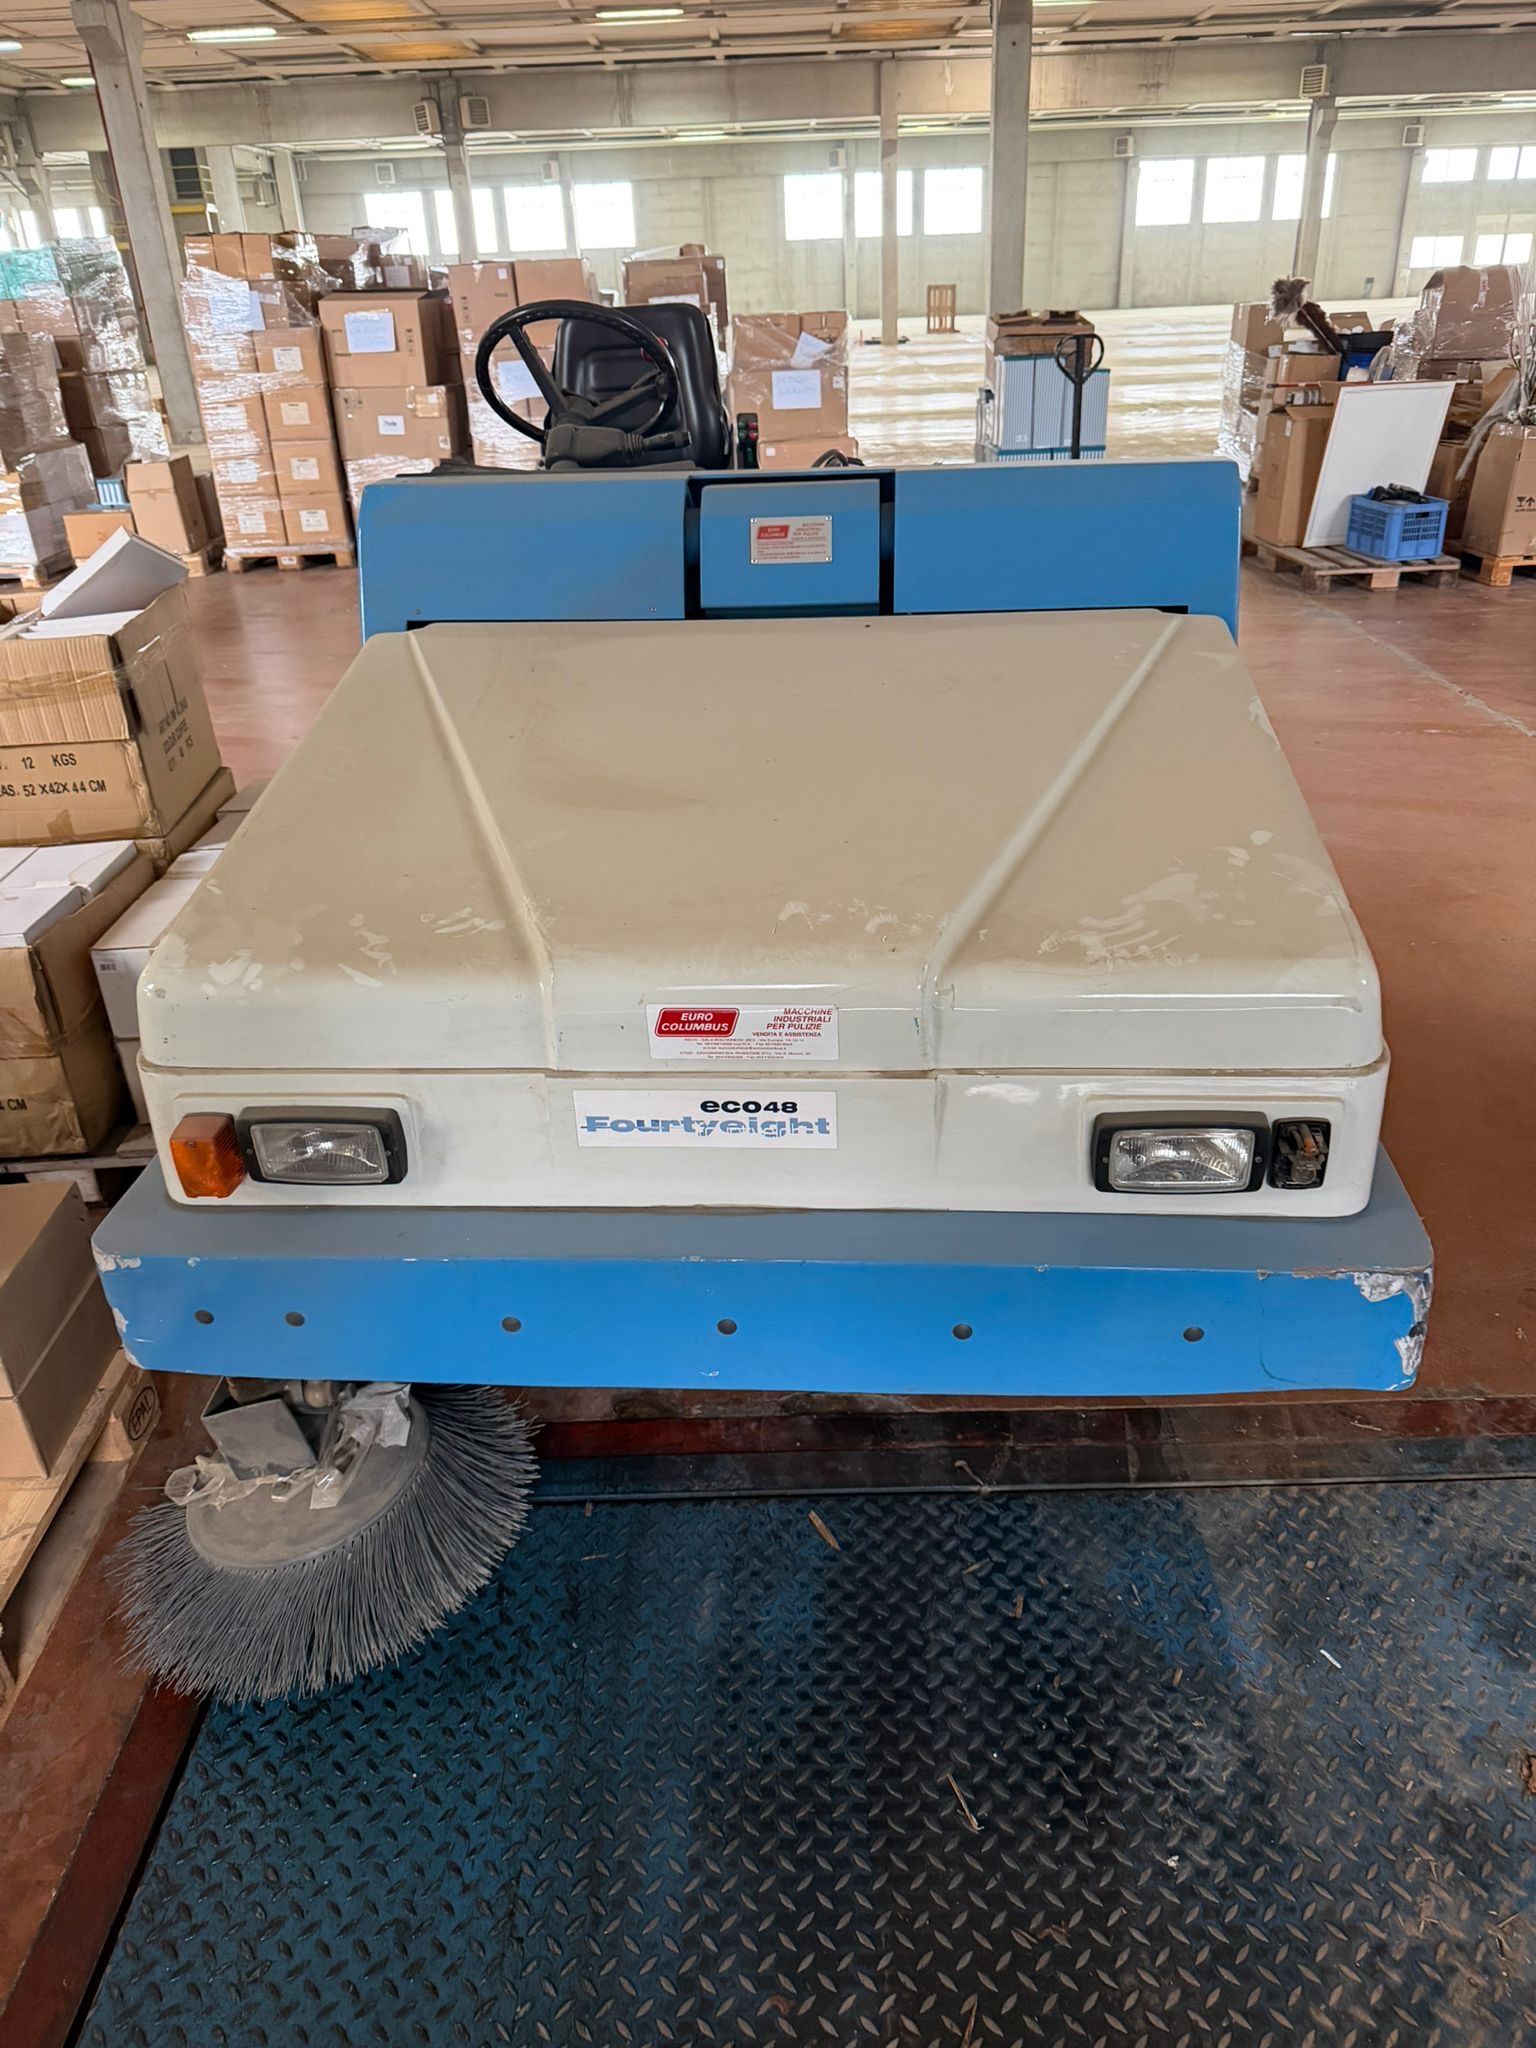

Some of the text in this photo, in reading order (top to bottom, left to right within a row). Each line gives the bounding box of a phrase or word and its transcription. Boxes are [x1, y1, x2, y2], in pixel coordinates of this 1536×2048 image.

[21, 756, 35, 770] 12
[51, 753, 78, 768] KGS
[88, 779, 107, 793] CM
[680, 1012, 714, 1021] EURO
[783, 1008, 833, 1016] MACCHINE
[773, 1015, 832, 1023] INDUSTRIALI
[661, 1022, 729, 1032] COLUMBUS
[7, 1098, 28, 1111] CM
[584, 1116, 831, 1138] Fourtyeight
[131, 1394, 152, 1434] EPAL
